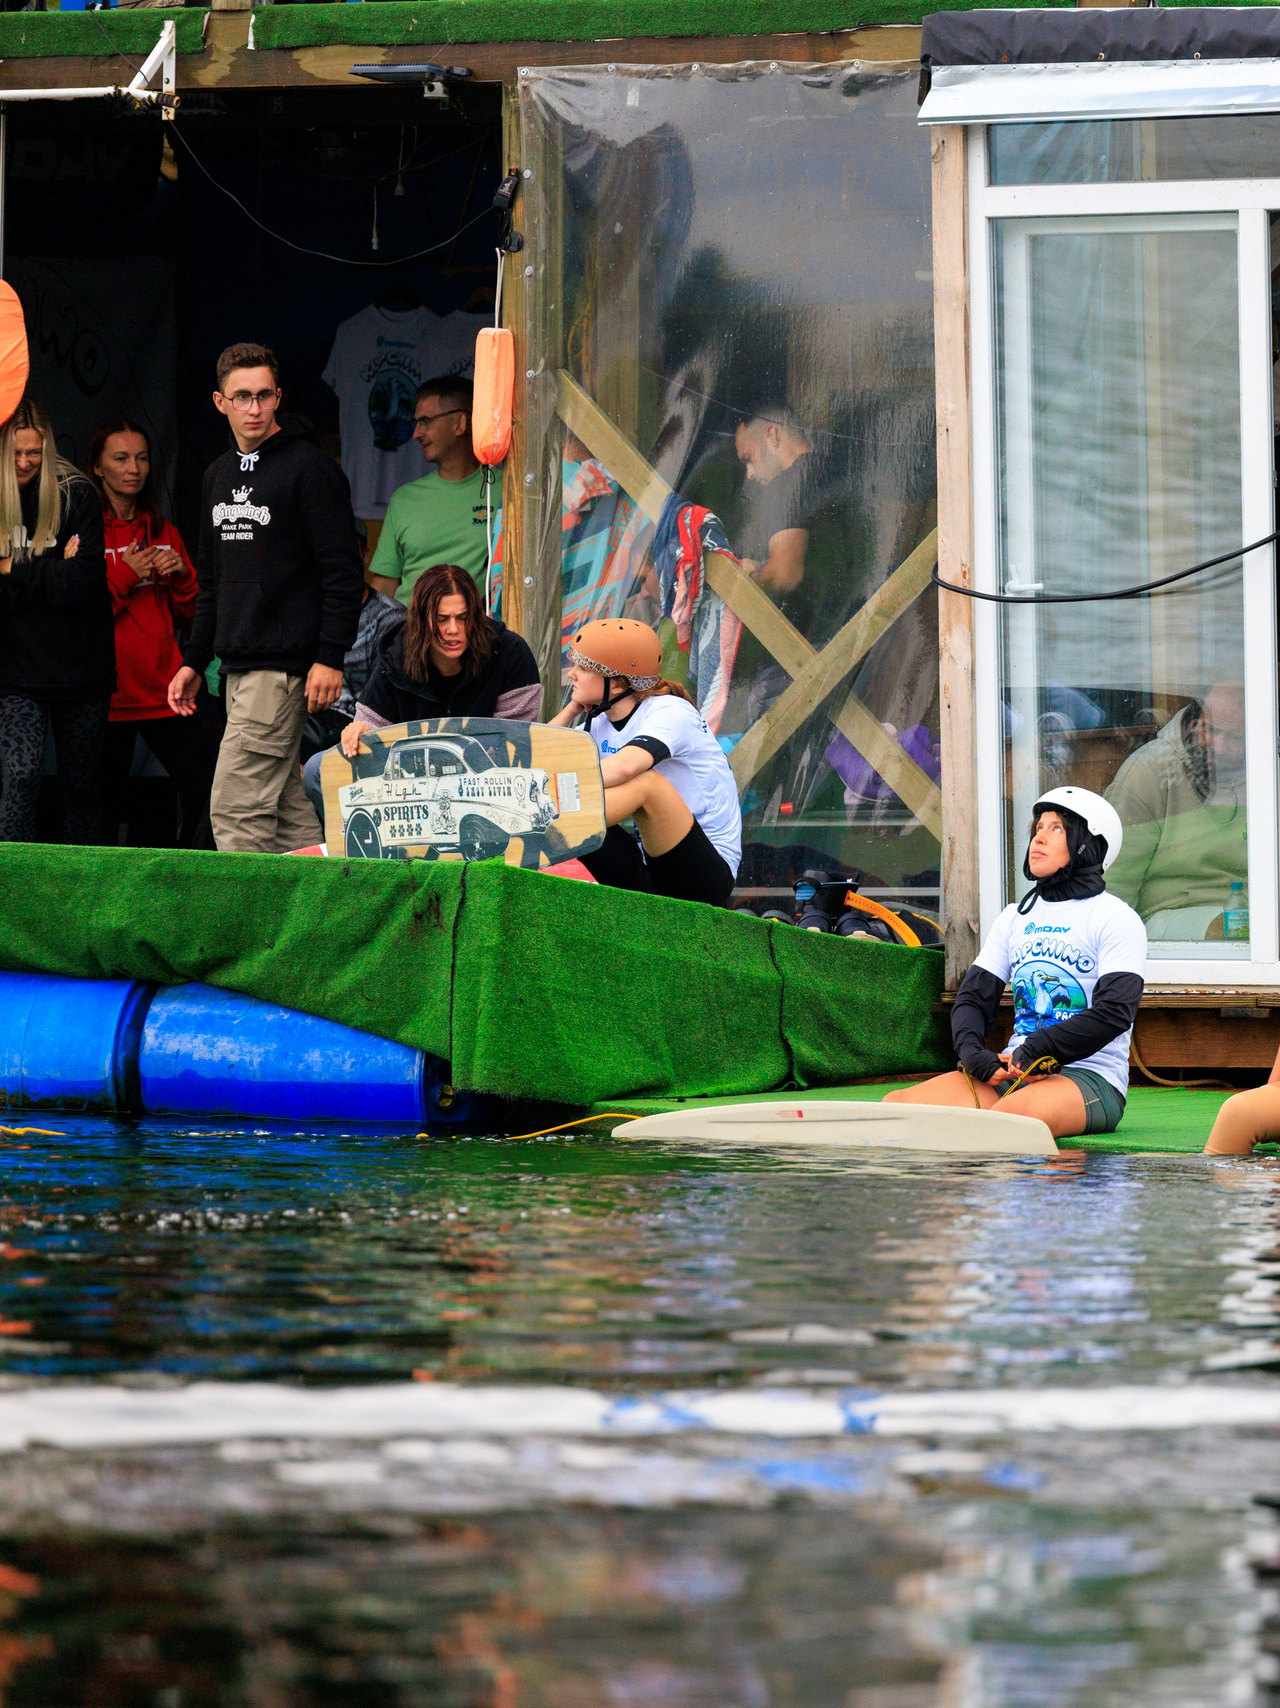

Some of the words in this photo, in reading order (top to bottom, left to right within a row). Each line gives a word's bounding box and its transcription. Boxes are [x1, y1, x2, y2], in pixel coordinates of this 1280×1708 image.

[221, 532, 235, 541] TEAM
[236, 532, 253, 541] RIDER
[463, 777, 480, 786] FAST
[484, 777, 512, 786] ROLLIN
[383, 804, 429, 822] SPIRITS
[1011, 937, 1095, 974] UPCHINO
